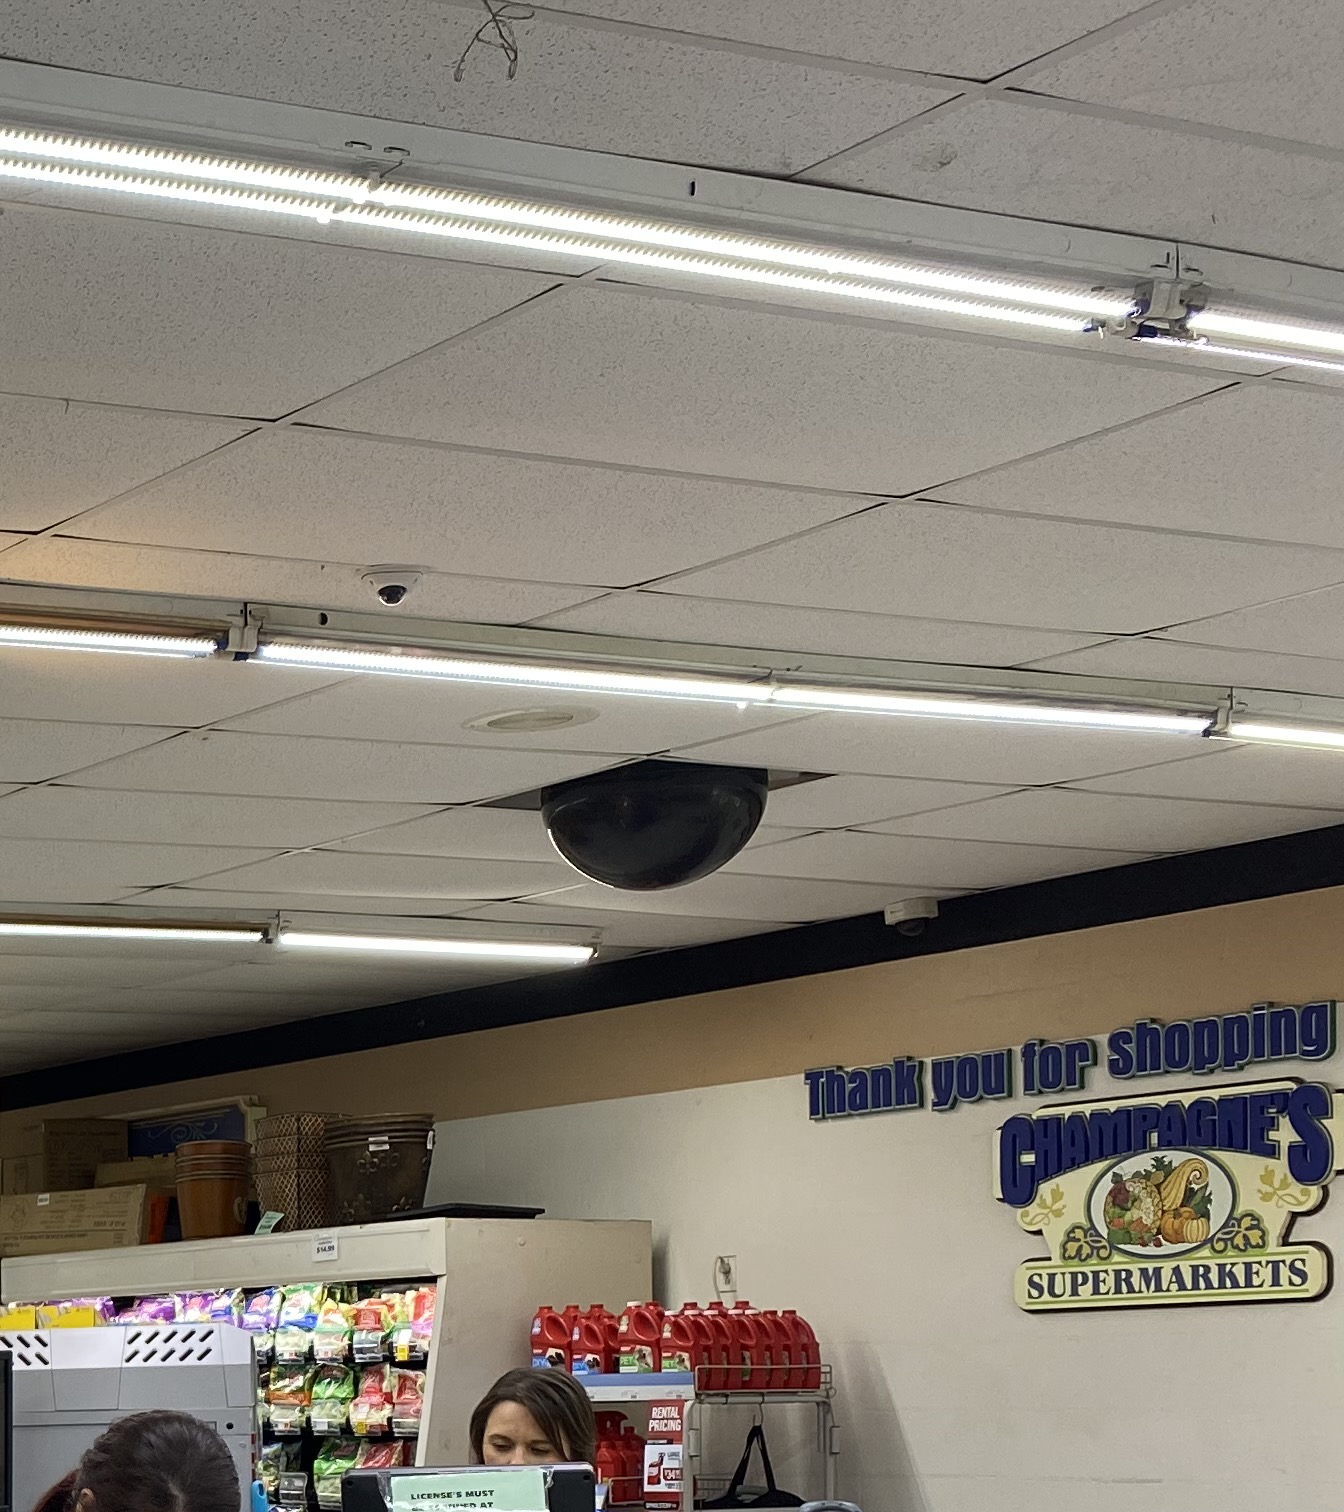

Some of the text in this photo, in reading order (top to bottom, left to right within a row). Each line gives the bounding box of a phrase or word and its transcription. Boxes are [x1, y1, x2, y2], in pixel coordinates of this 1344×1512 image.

[805, 1001, 1336, 1120] Thank you for shopping
[999, 1083, 1333, 1208] CHAMPAGNE'S
[1027, 1257, 1309, 1300] SUPERMARKETS
[648, 1419, 681, 1432] PRICING
[651, 1407, 680, 1419] RENTAL
[411, 1490, 494, 1500] LICENSE'S MUST
